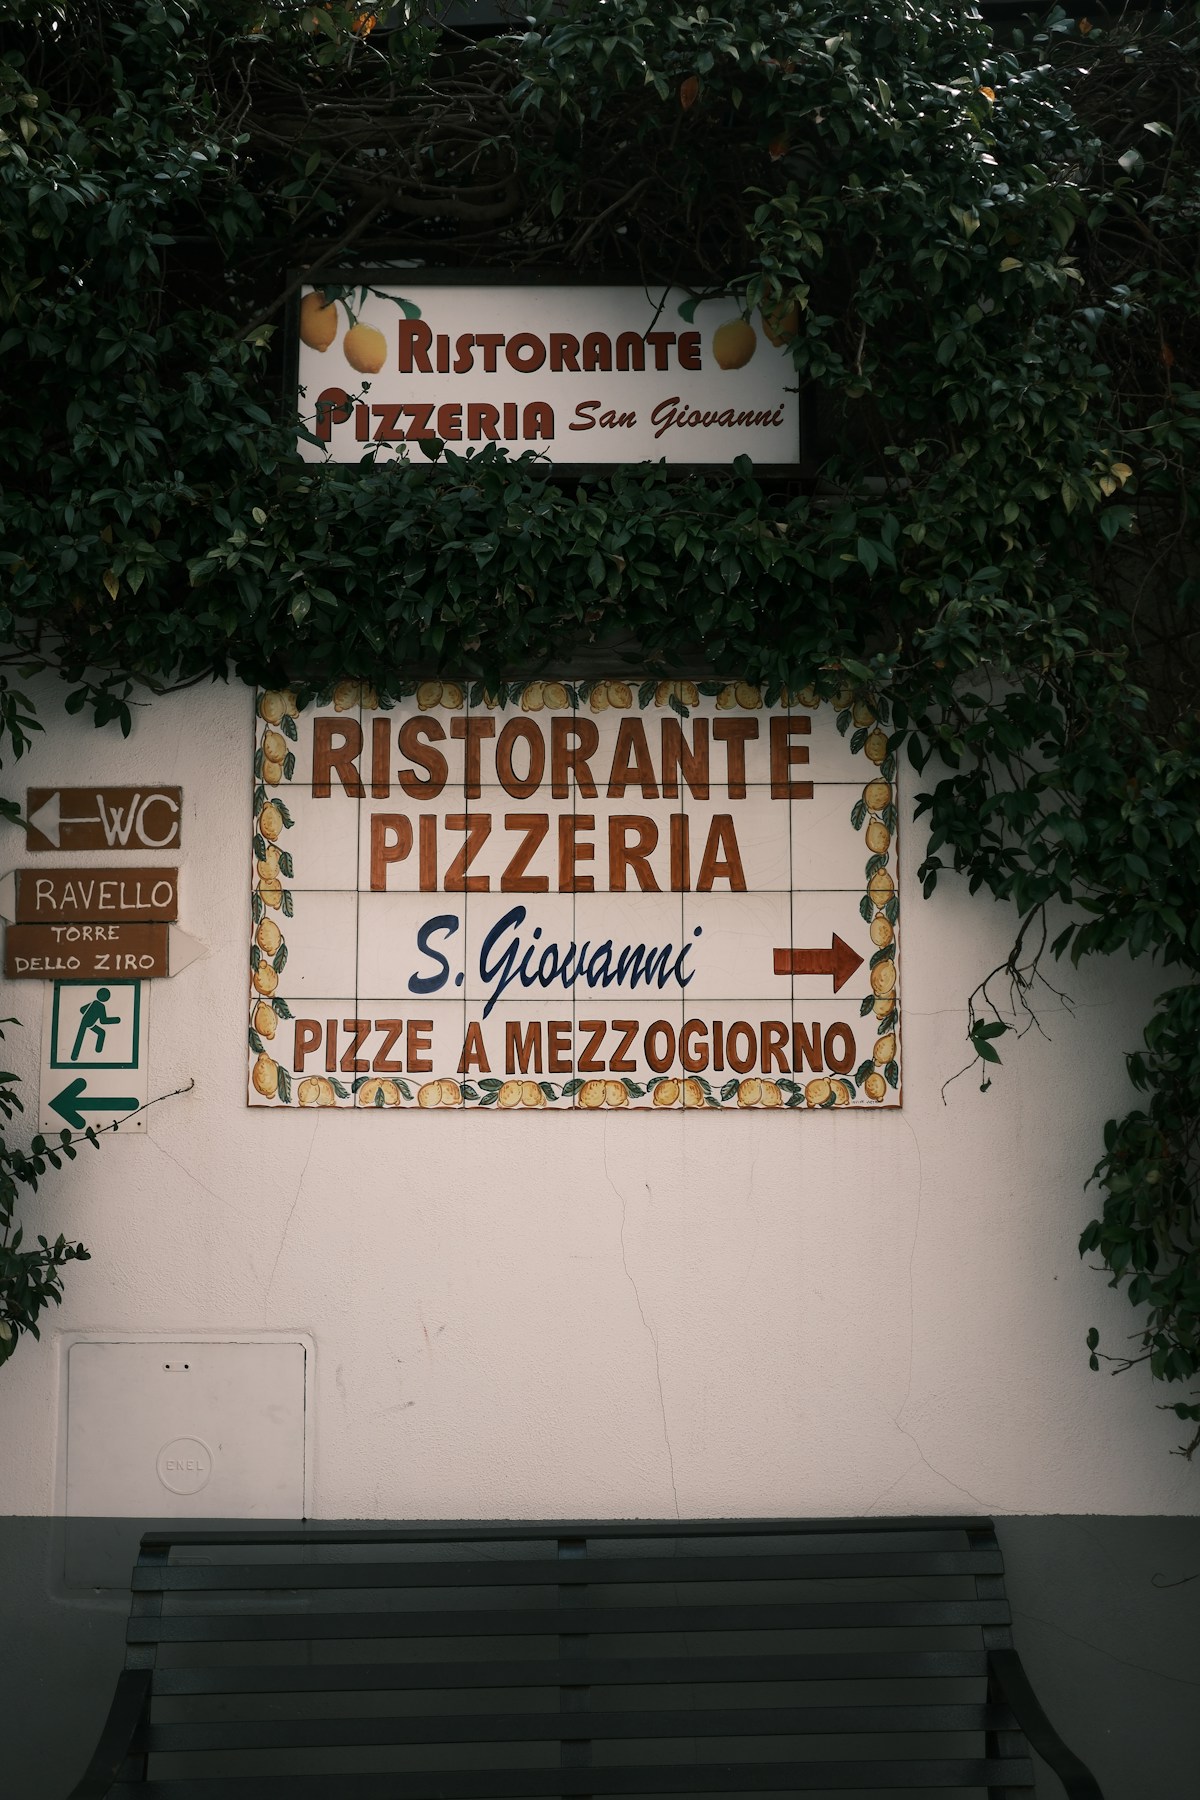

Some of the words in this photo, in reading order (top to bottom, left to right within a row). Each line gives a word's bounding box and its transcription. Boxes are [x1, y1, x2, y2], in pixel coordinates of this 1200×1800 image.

[398, 319, 702, 373] RISTORANTE
[316, 387, 554, 442] PIZZERIA
[568, 400, 637, 432] San
[651, 397, 785, 439] Giovanni
[311, 715, 814, 800] RISTORANTE
[96, 793, 180, 847] WC
[370, 813, 748, 892] PIZZERIA
[35, 879, 173, 911] RAVELLO
[51, 925, 120, 943] TORRE
[15, 956, 80, 973] DELLO
[94, 954, 155, 971] ZIRO
[408, 914, 465, 994] S.
[479, 905, 703, 1019] Giovanni
[293, 1019, 434, 1073] PIZZE
[457, 1020, 491, 1074] A
[504, 1019, 857, 1075] MEZZOGIORNO
[166, 1460, 204, 1471] ENEL
